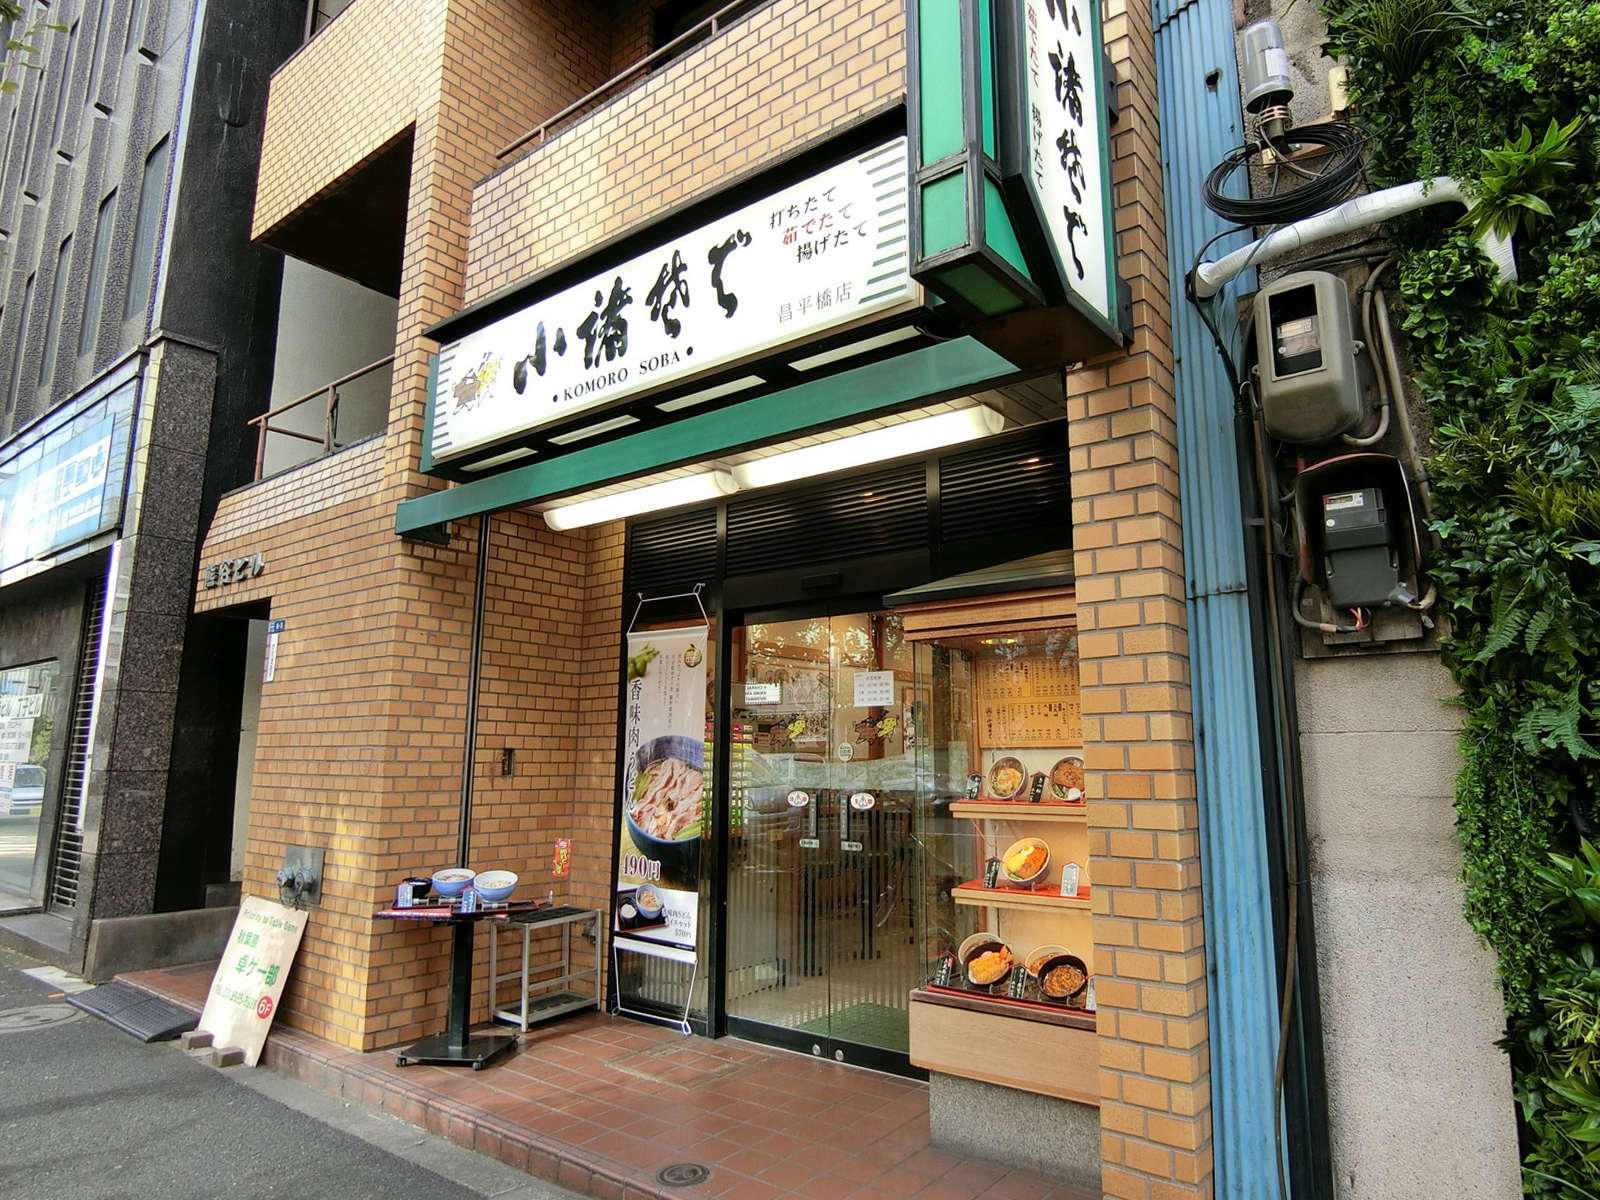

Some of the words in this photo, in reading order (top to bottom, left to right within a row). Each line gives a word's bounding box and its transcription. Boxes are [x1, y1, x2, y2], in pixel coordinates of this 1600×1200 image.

[1032, 102, 1043, 190] 揚げたて
[769, 186, 837, 229] 打ちたて
[782, 202, 852, 246] 茹でたて
[796, 220, 868, 264] 揚げたて
[779, 281, 852, 324] 昌平橋店
[563, 367, 629, 402] KOMORO
[638, 351, 682, 377] SOBA
[626, 679, 643, 812] 香味肉うどん
[623, 855, 661, 880] 490円
[238, 929, 260, 949] 秋葉原
[243, 909, 261, 924] Priority
[269, 916, 283, 929] Table
[283, 920, 298, 934] Game
[235, 953, 281, 987] 卓ゲー部
[258, 998, 272, 1016] 6F
